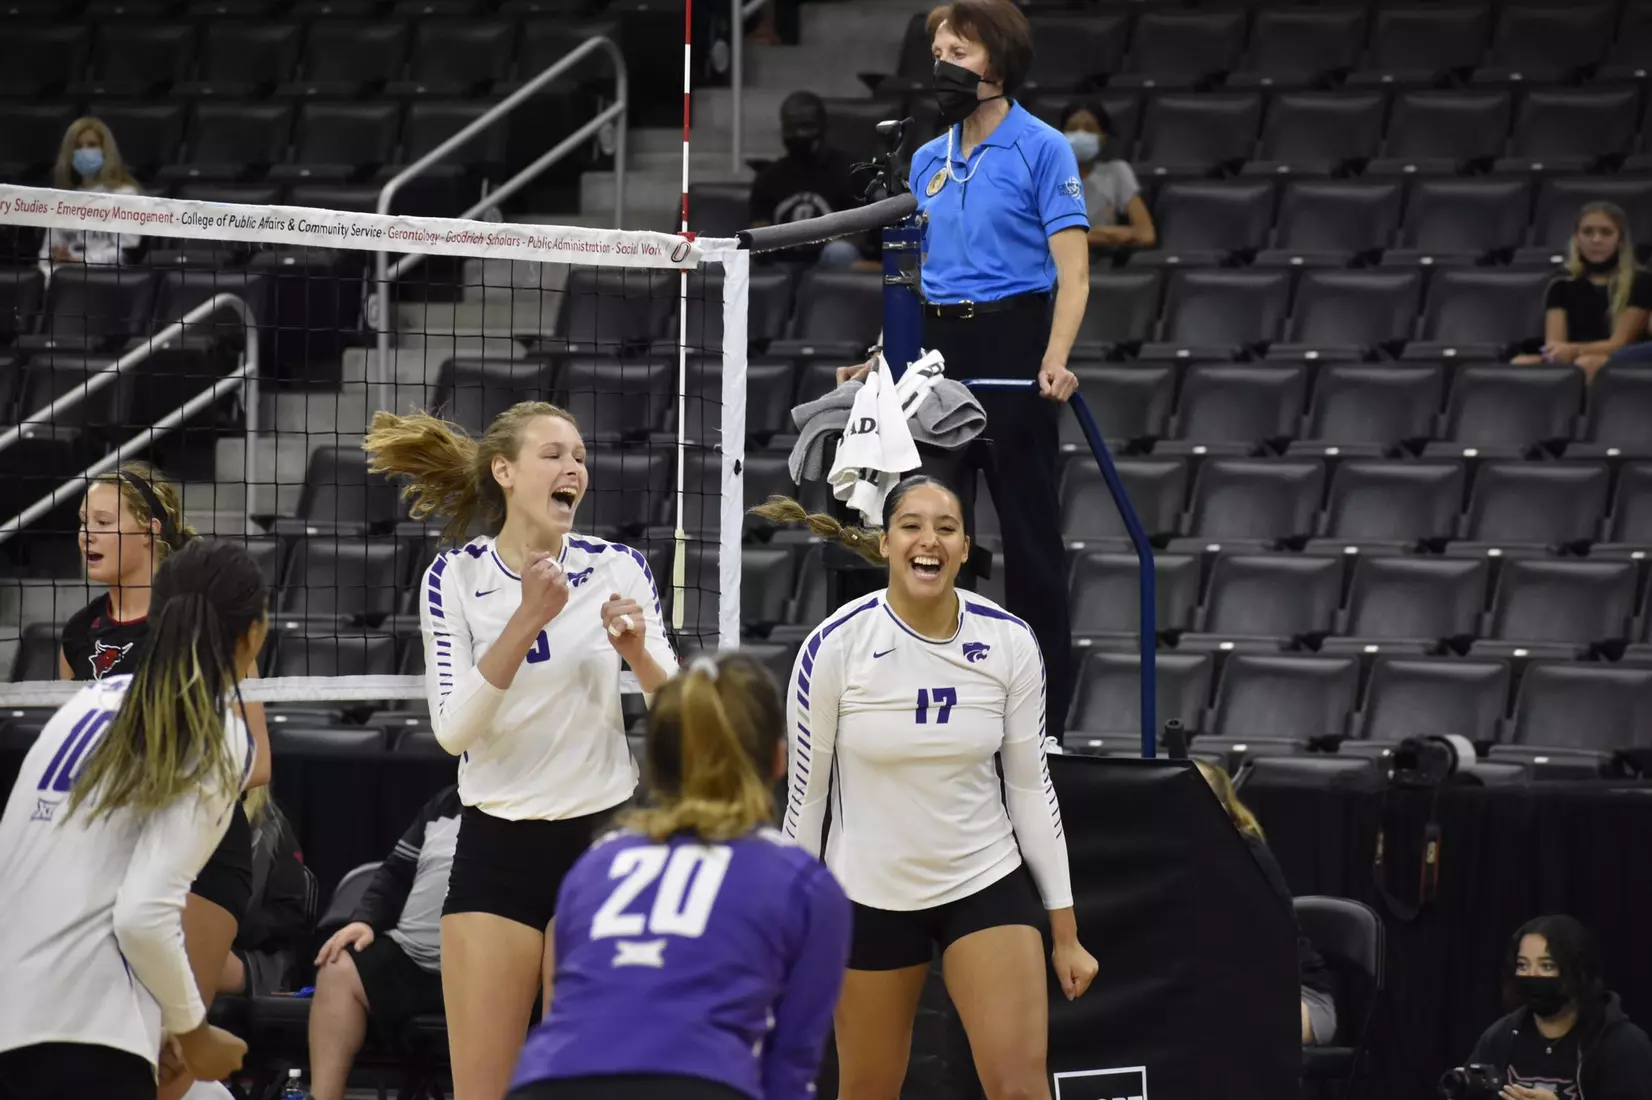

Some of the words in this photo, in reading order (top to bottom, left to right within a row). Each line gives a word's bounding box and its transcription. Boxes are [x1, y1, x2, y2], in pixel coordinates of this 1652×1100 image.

[14, 198, 48, 213] Studies
[56, 201, 110, 221] Emergency
[112, 206, 174, 225] Management
[181, 211, 214, 229] College
[216, 213, 228, 227] of
[228, 214, 257, 229] Public
[258, 216, 285, 230] Affairs
[287, 218, 296, 231] &
[298, 219, 349, 239] Community
[350, 223, 382, 238] Service
[387, 226, 440, 245] Gerontology
[446, 230, 484, 244] Goodrich
[486, 232, 520, 247] Scholars
[527, 235, 553, 250] Public
[552, 237, 611, 253] Administration
[616, 241, 638, 255] Social
[641, 243, 663, 256] Work
[915, 687, 957, 724] 17
[590, 844, 733, 941] 20
